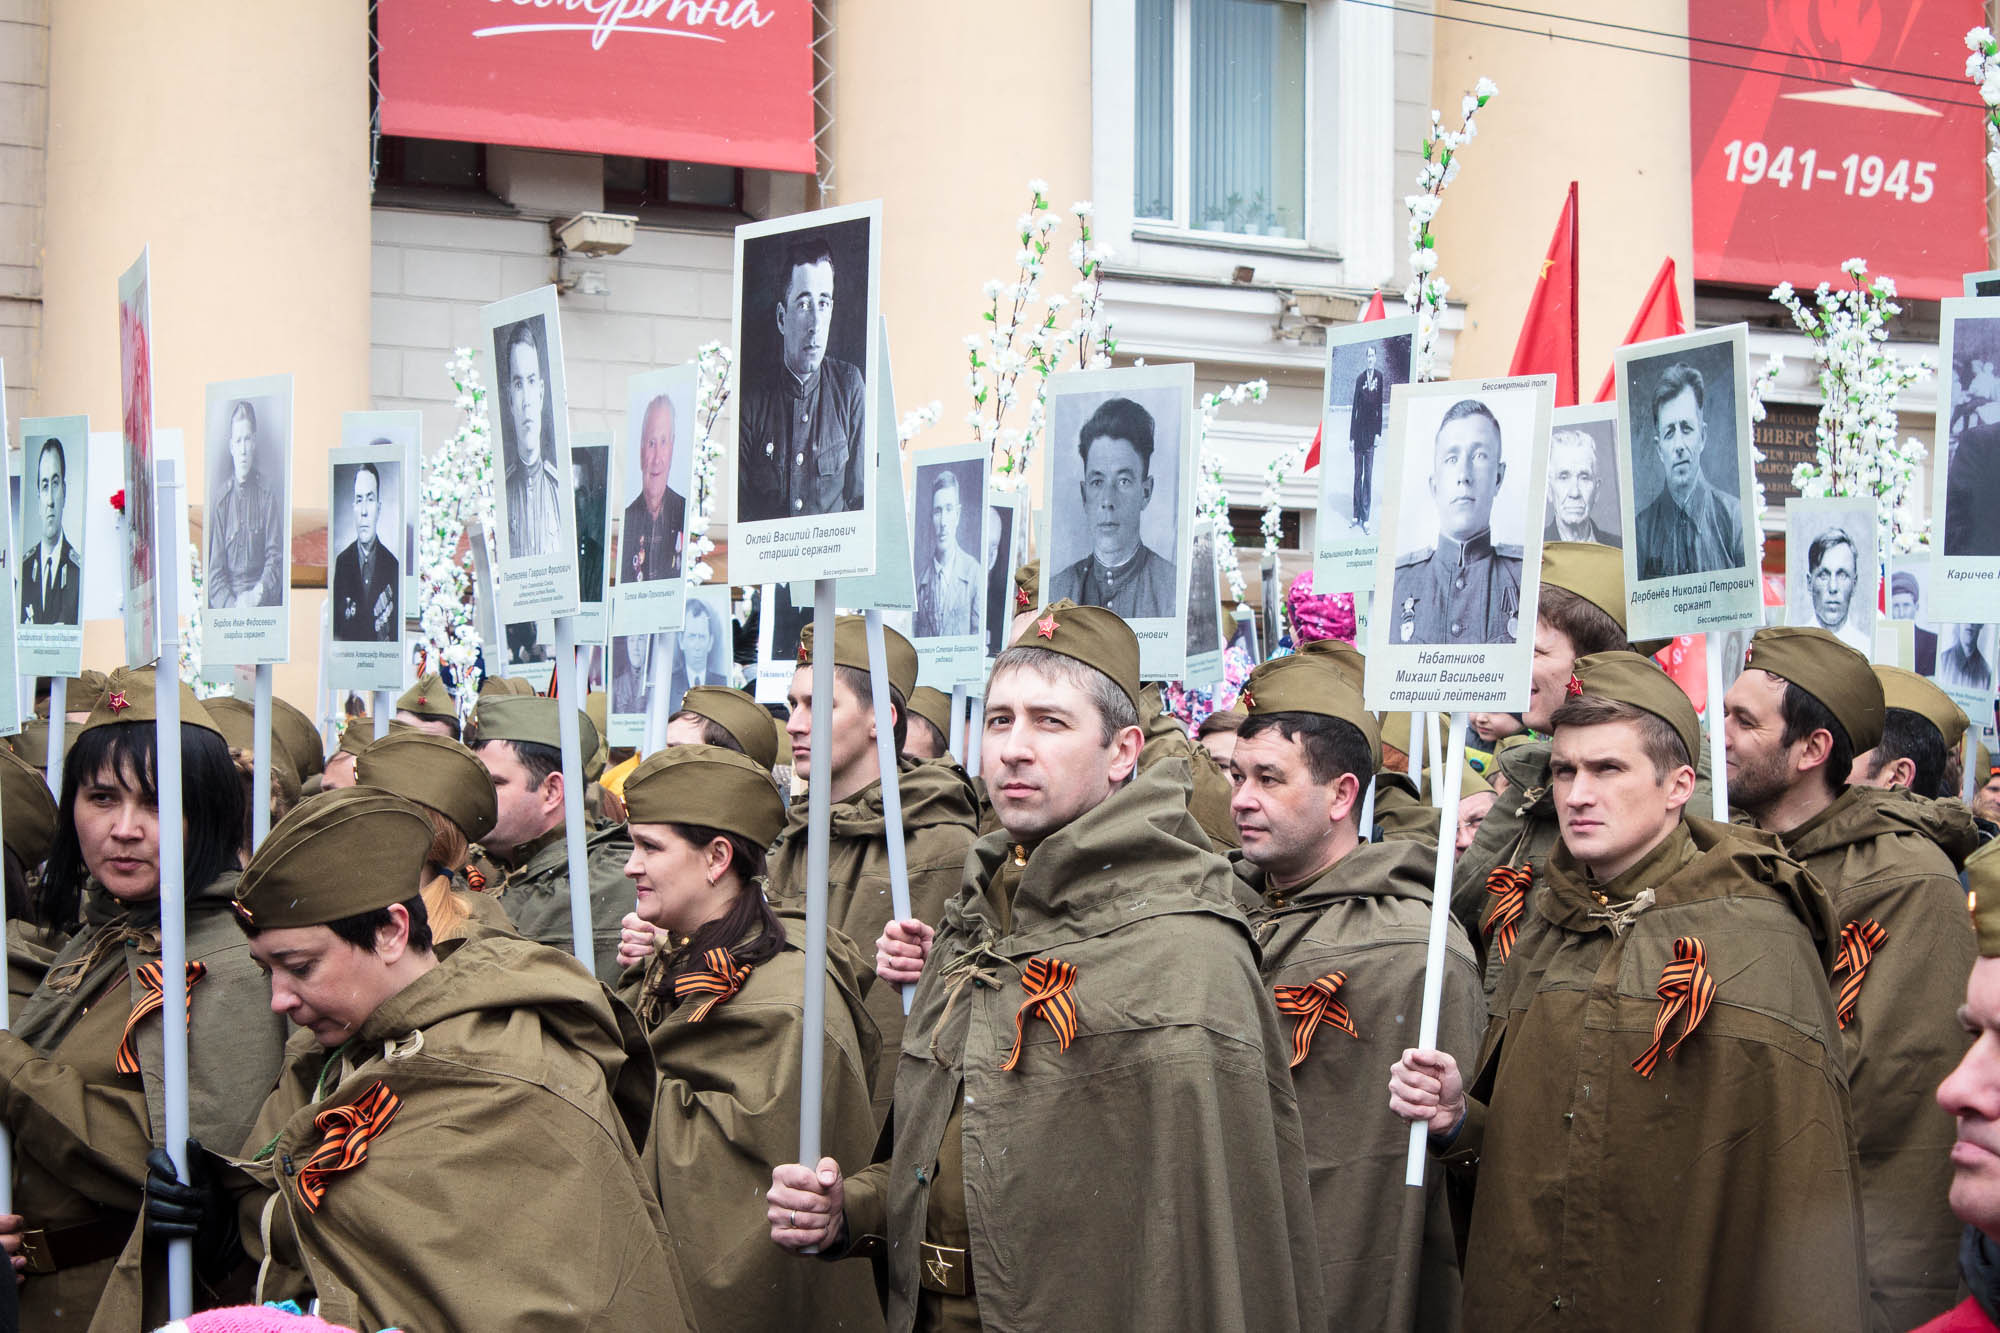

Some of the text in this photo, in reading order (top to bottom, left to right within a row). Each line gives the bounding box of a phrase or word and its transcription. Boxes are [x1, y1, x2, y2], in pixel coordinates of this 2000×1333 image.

[1482, 380, 1529, 390] Бессмертный
[745, 525, 856, 546] Оклей Василий Павлович
[759, 544, 841, 560] старший сержант
[1947, 570, 1993, 581] Каричев
[1631, 579, 1754, 604] Дербенёв Николай Петрович
[1673, 600, 1711, 614] сержант
[1697, 613, 1738, 624] Бессмертный
[1418, 651, 1486, 664] Набатников
[1396, 670, 1504, 683] Михаил Васильевич
[1389, 689, 1507, 703] старший лейтенант
